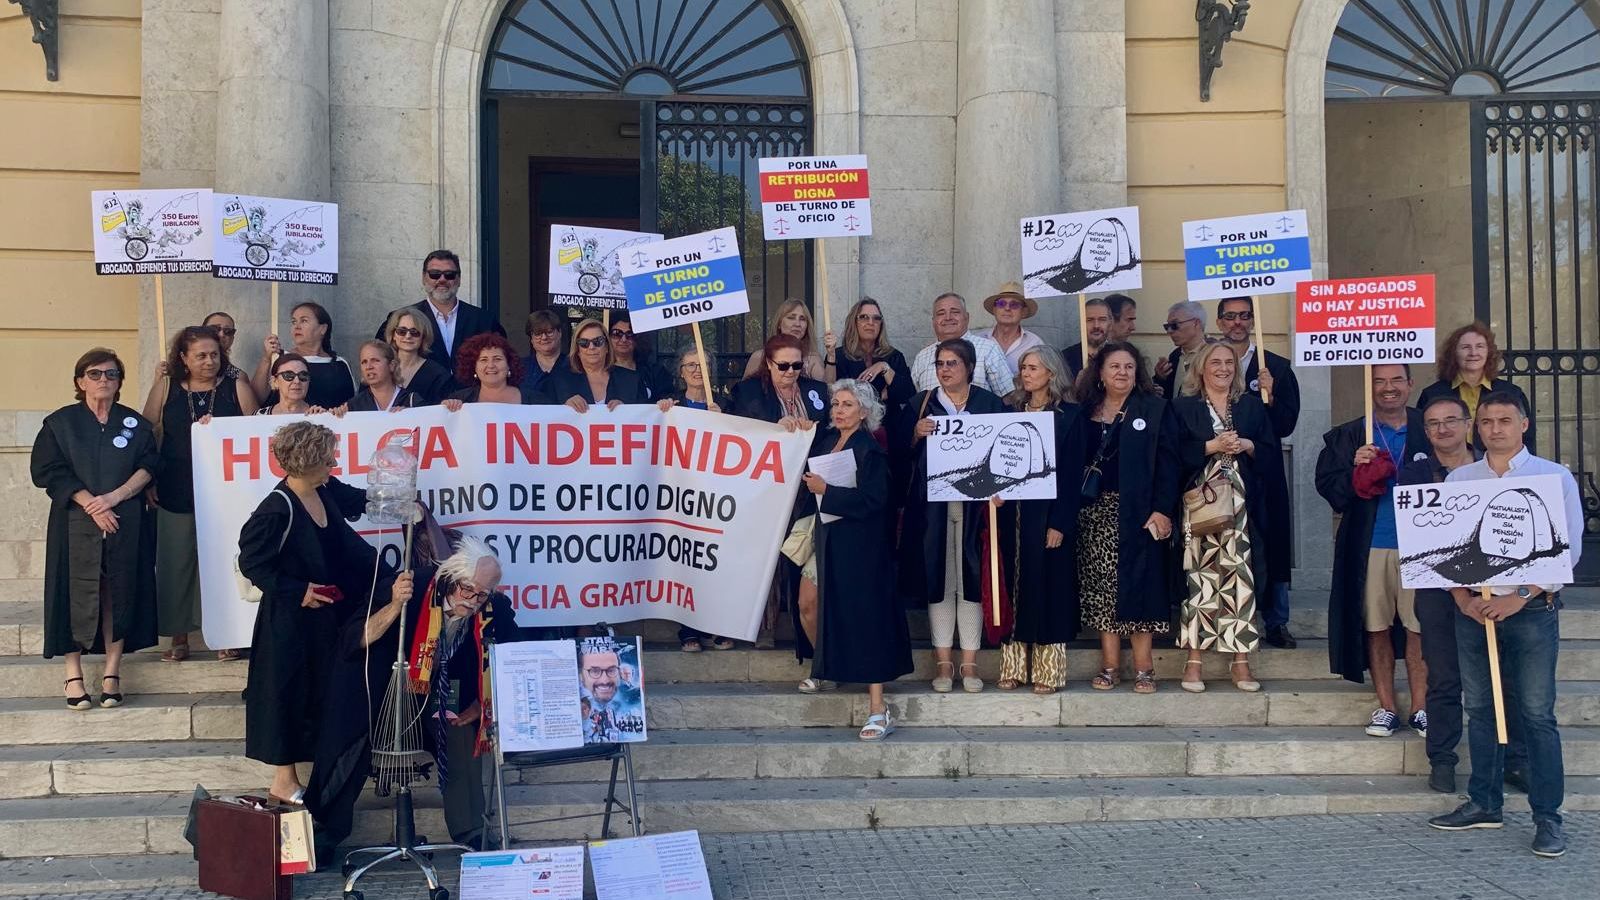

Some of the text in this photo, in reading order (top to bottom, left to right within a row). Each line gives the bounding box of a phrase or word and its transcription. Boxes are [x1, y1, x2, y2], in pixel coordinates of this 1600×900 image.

[788, 160, 837, 170] POR UNA
[768, 171, 858, 186] RETRIBUCIÓN
[794, 188, 836, 199] DIGNA
[104, 198, 118, 210] #J2
[225, 202, 241, 213] #J2
[776, 200, 856, 212] DEL TURNO DE
[798, 214, 835, 222] OFICIO
[302, 224, 322, 232] Euros
[1022, 219, 1056, 237] #J2
[561, 234, 576, 244] #J2
[1220, 229, 1268, 243] POR UN
[1216, 243, 1275, 259] TURNO
[655, 252, 702, 268] POR UN
[1205, 257, 1290, 276] DE OFICIO
[101, 261, 212, 274] ABOGADO, DEFIENDE TUS DERECHOS
[218, 267, 333, 283] ABOGADO, DEFIENDE TUS DERECHOS
[653, 265, 710, 286] TURNO
[1221, 275, 1276, 290] DIGNO
[1310, 280, 1416, 296] SIN ABOGADOS
[644, 280, 725, 306] DE OFICIO
[553, 295, 585, 307] ABOGADO,
[586, 298, 615, 308] DEFIENDE
[1302, 297, 1425, 313] NO HAY JUSTICIA
[662, 300, 713, 320] DIGNO
[1327, 314, 1398, 328] GRATUITA
[1310, 331, 1417, 345] POR UN TURNO
[1304, 348, 1424, 361] DE OFICIO DIGNO
[485, 422, 786, 484] INDEFINIDA
[417, 483, 737, 522] URNO DE OFICIO DIGNO
[1397, 488, 1442, 510] #J2
[1488, 504, 1530, 514] MUTUALISTA
[1492, 512, 1525, 521] RECLAME
[1492, 528, 1524, 537] PENSIÓN
[505, 534, 523, 564] Y
[529, 532, 719, 572] PROCURADORES
[580, 580, 696, 612] GRATUITA
